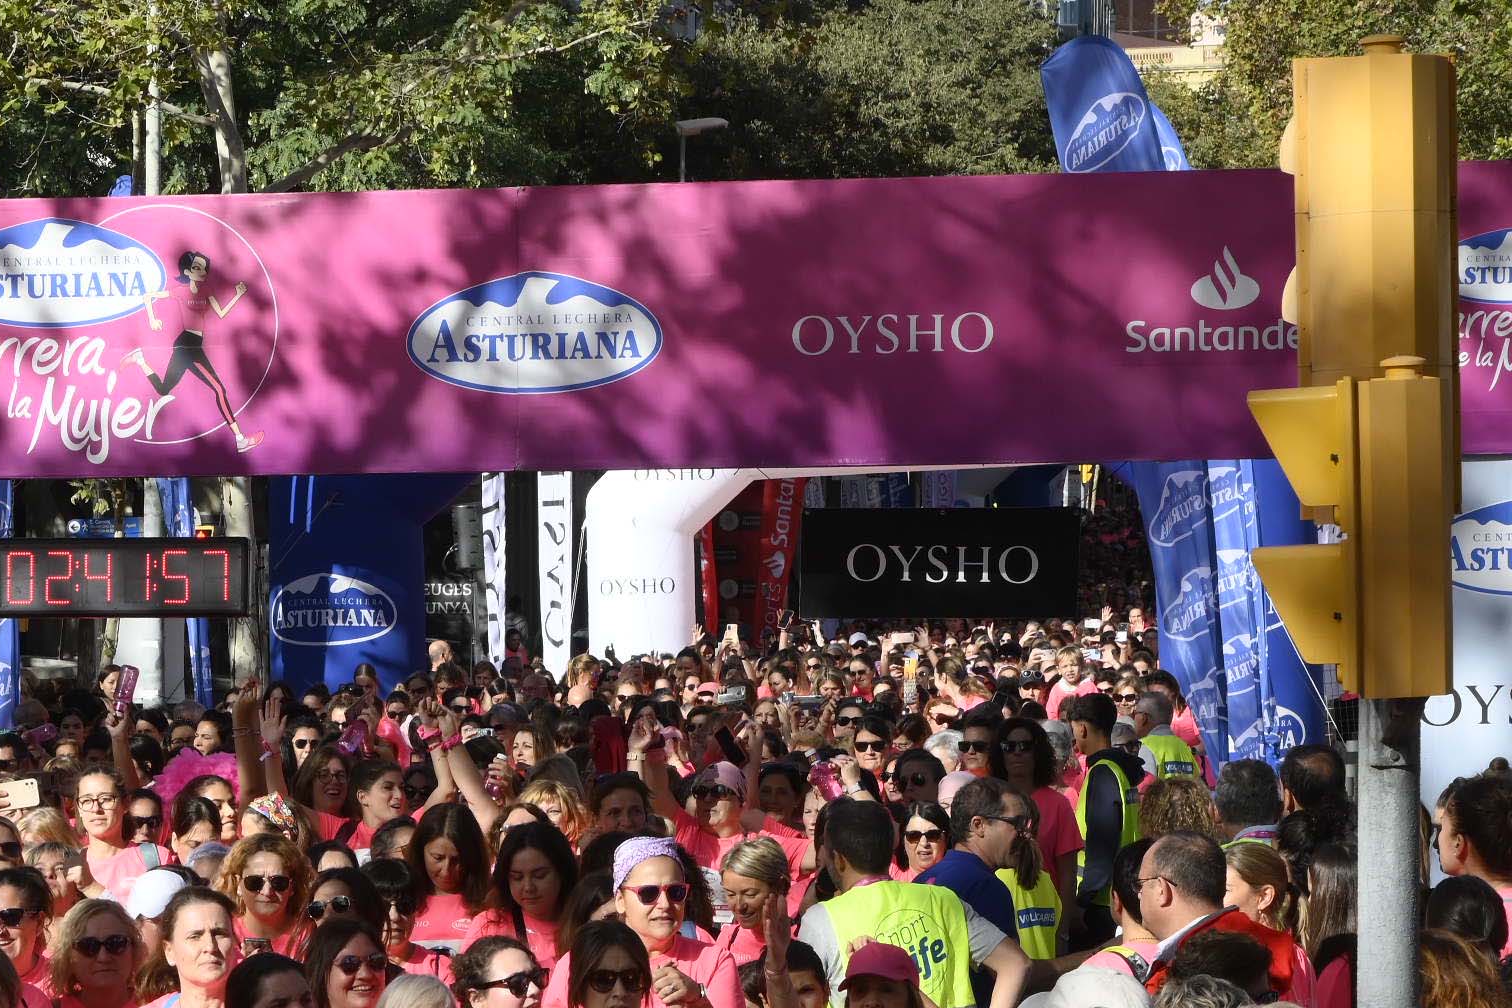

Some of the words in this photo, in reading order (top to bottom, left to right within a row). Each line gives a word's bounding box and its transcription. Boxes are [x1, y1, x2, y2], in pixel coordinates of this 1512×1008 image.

[70, 255, 141, 267] LECHERA
[466, 314, 545, 328] CENTRAL
[553, 312, 633, 325] LECHERA
[791, 312, 995, 356] OYSHO
[427, 319, 642, 364] ASTURIANA
[7, 378, 31, 419] la
[26, 371, 177, 465] Mujer
[771, 479, 795, 548] Santa
[6, 550, 230, 605] 02:41:57
[845, 543, 1039, 584] OYSHO
[601, 577, 676, 595] OYSHO
[275, 601, 389, 630] ASTURIANA
